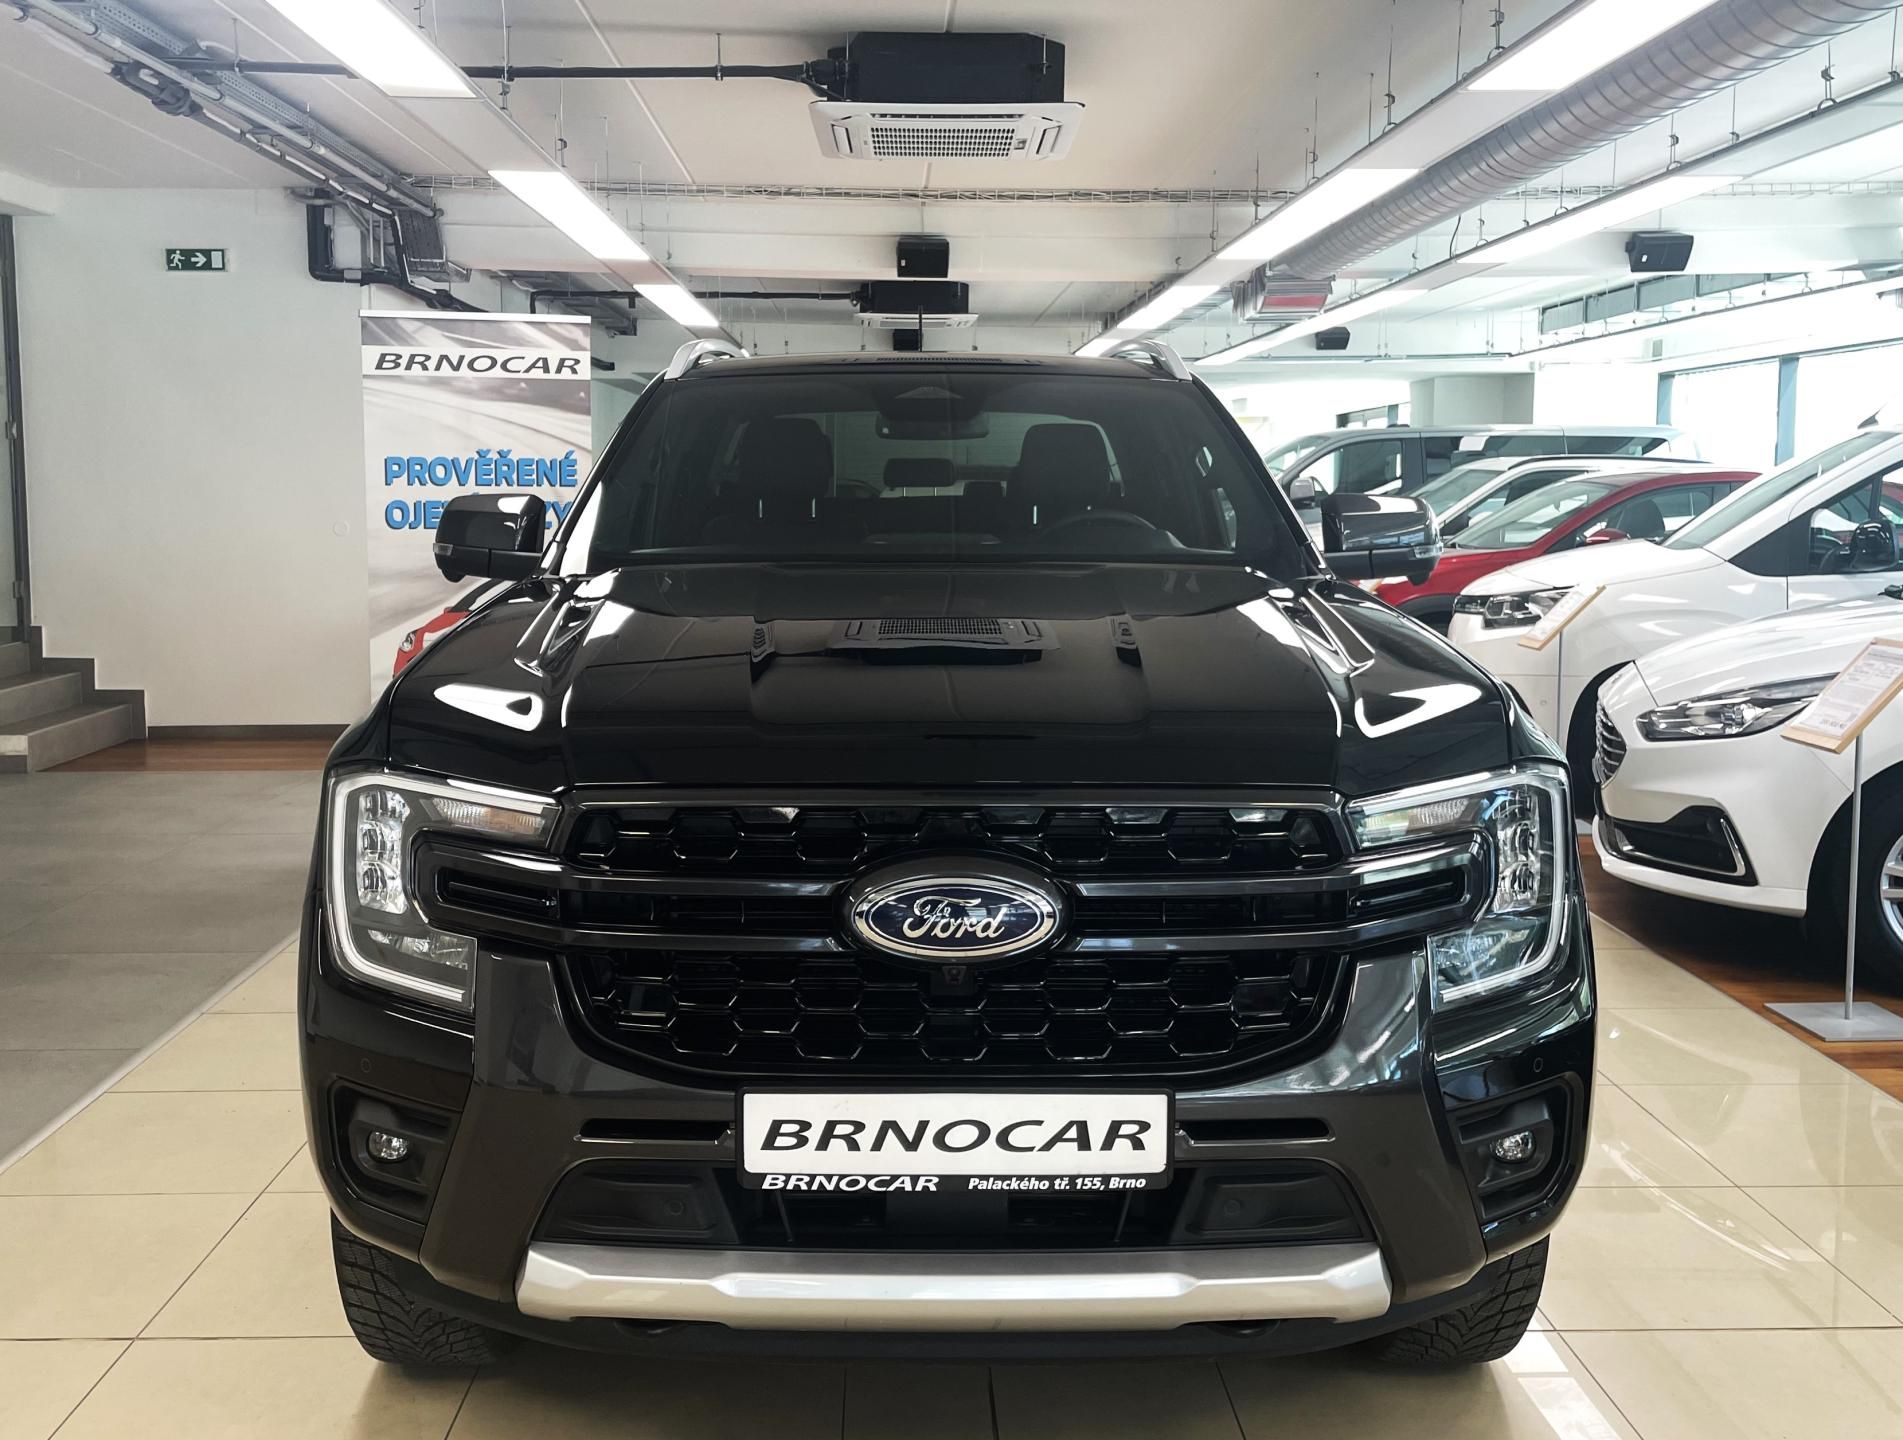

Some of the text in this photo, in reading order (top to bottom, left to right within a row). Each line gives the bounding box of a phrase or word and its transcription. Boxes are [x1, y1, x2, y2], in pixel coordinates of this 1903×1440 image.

[374, 352, 581, 375] BRNOCAR
[384, 449, 578, 487] PROVĚŘENÉ
[902, 896, 1008, 938] Ford
[759, 1118, 1152, 1153] BRNOCAR
[761, 1174, 940, 1192] BRNOCAR
[968, 1176, 1147, 1191] Palackého tř. 155, Brno
